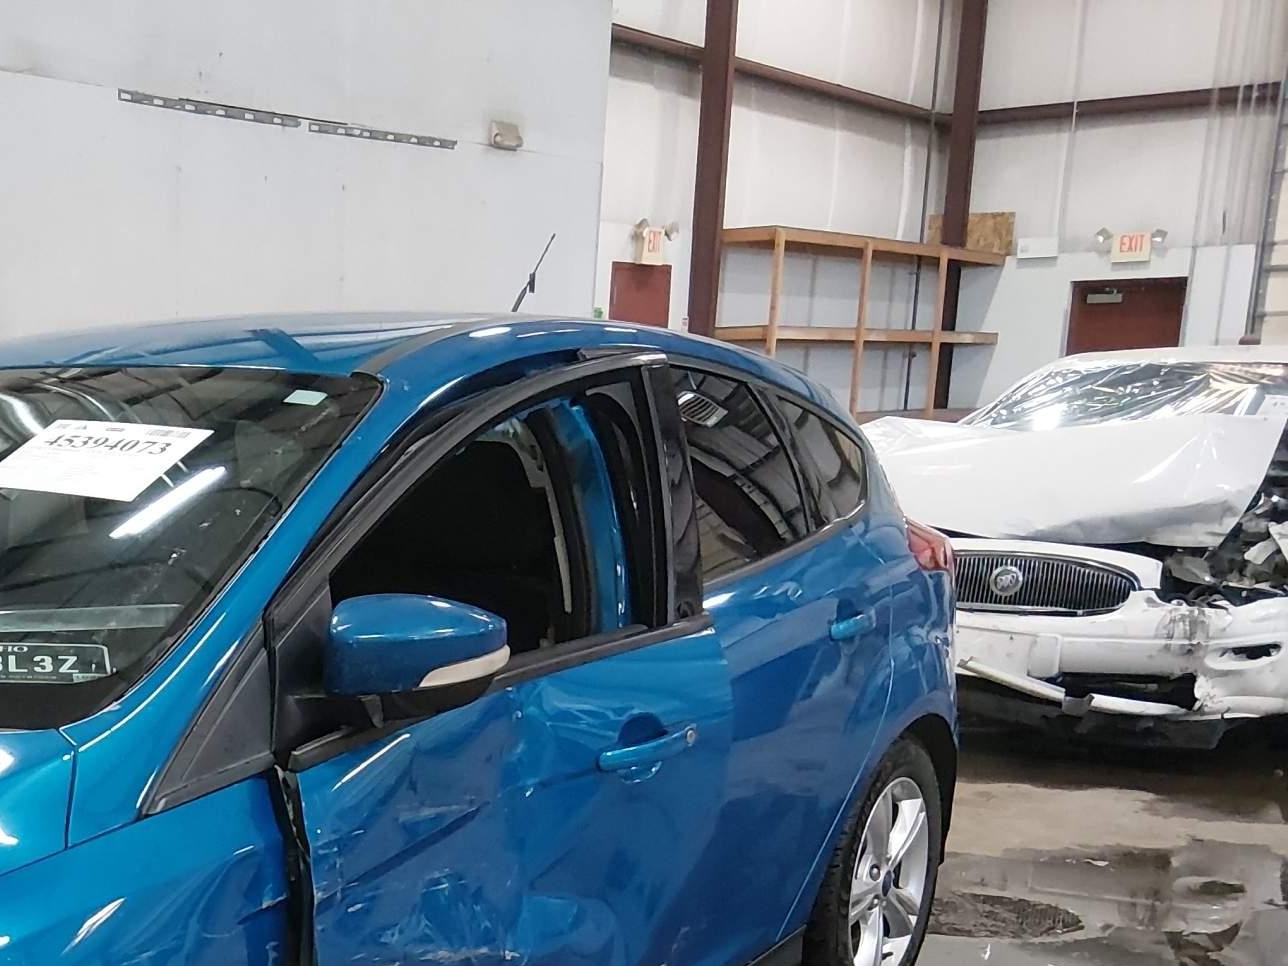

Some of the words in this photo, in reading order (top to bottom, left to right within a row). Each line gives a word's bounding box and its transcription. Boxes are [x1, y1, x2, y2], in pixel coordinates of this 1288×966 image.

[648, 230, 663, 253] EXIT
[1119, 233, 1145, 253] EXIT
[44, 434, 172, 455] 45394073
